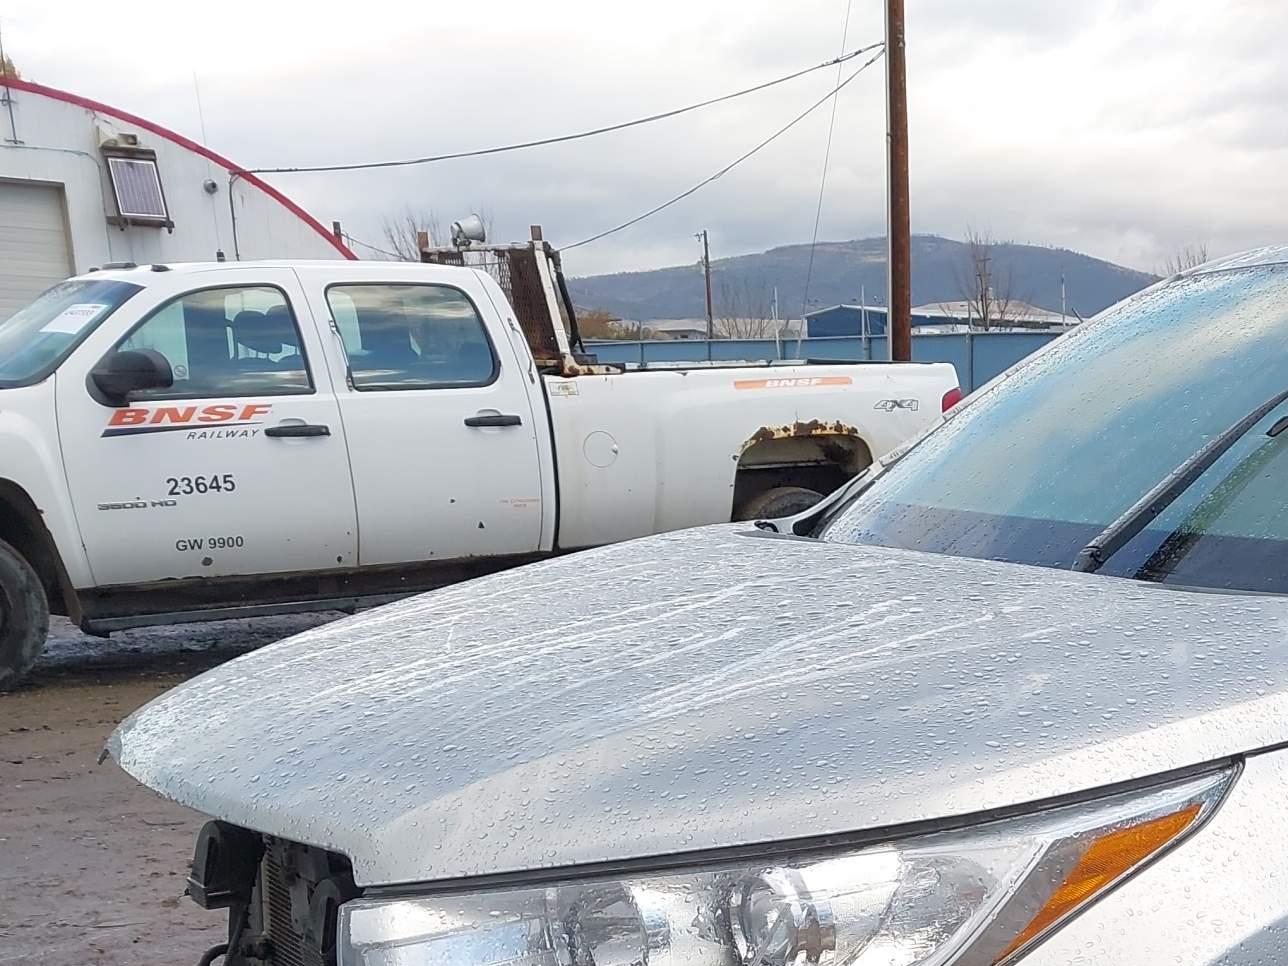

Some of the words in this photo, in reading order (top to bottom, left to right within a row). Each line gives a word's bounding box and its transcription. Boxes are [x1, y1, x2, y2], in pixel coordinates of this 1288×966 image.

[766, 378, 824, 388] BNSF
[108, 404, 273, 426] BNSF
[186, 429, 260, 440] RAILWAY
[166, 474, 236, 496] 23645
[175, 538, 204, 551] GW
[208, 535, 244, 550] 9900
